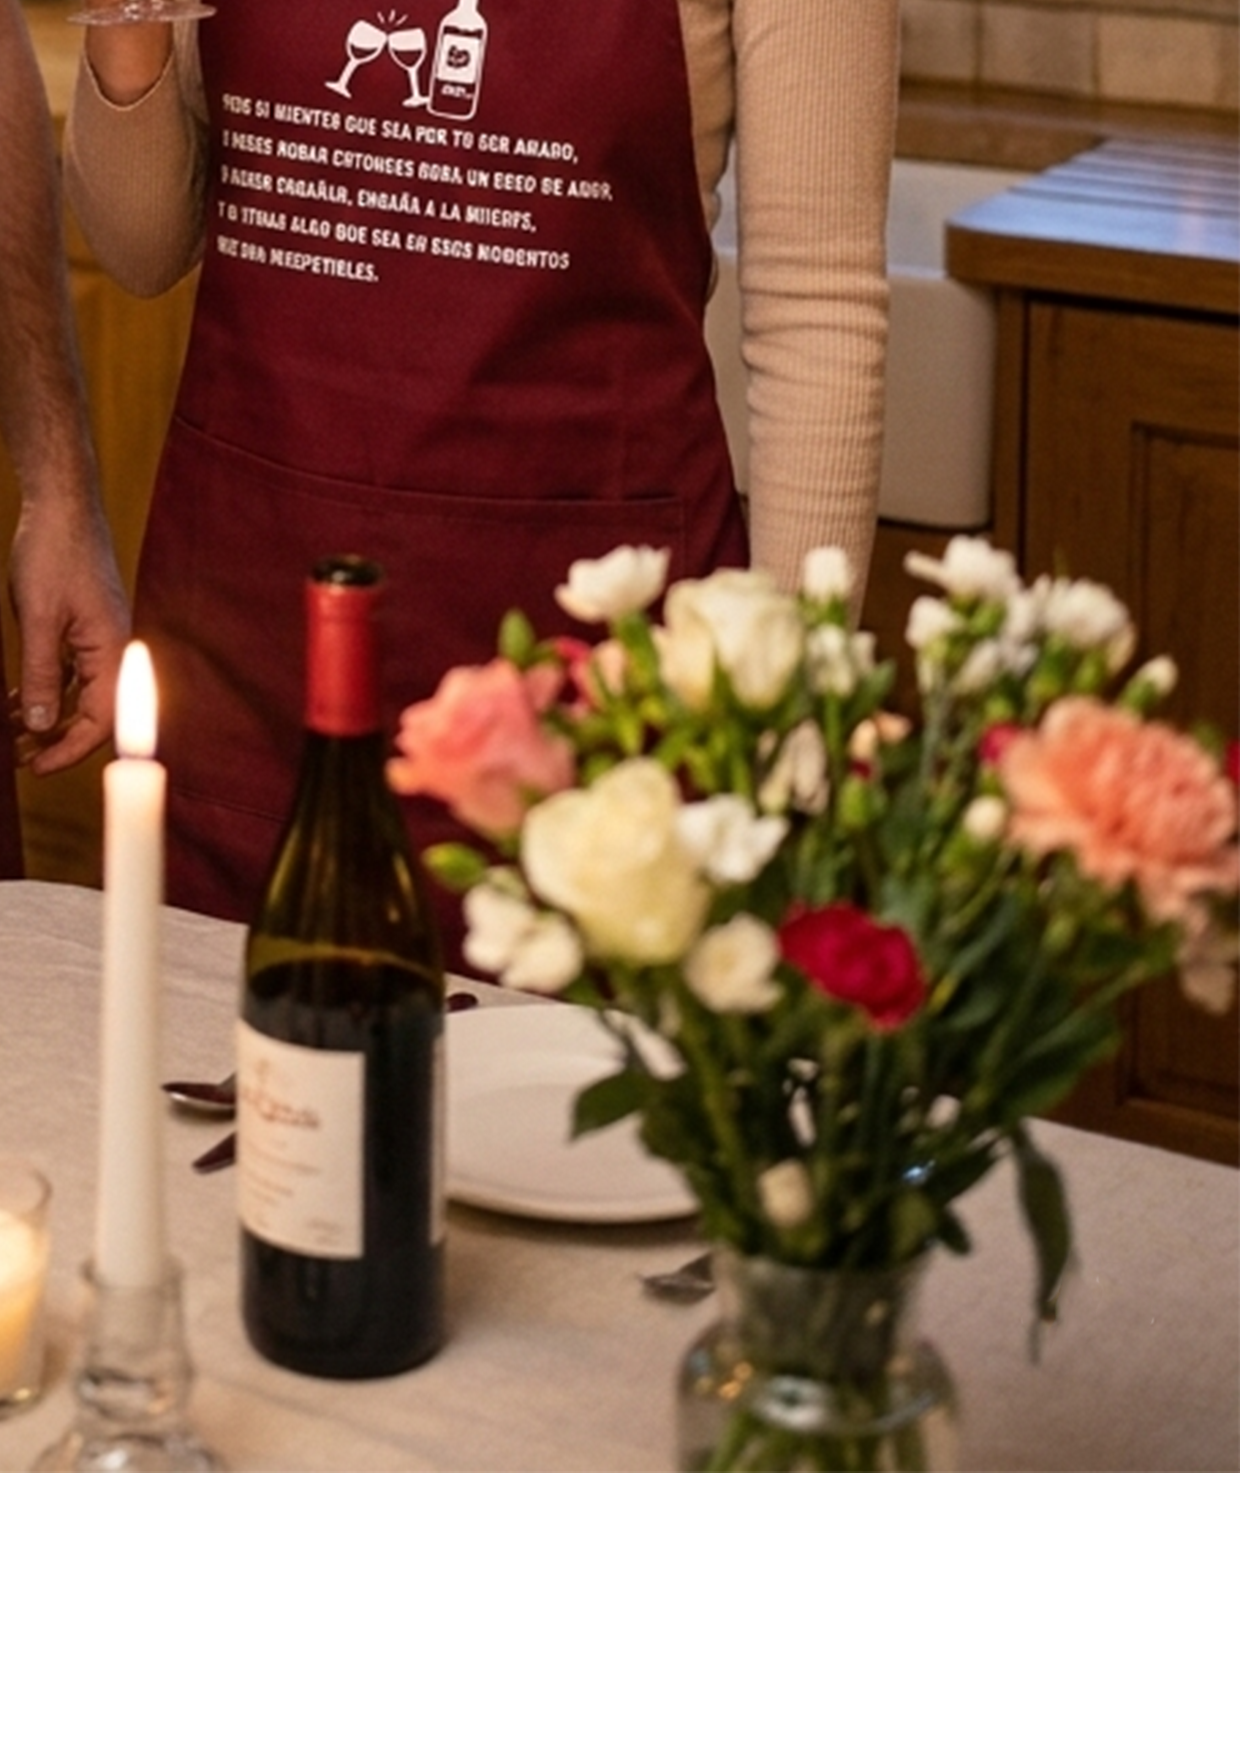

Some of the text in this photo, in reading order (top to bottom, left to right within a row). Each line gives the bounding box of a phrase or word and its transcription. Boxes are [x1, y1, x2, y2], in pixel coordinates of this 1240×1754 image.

[424, 199, 436, 217] A
[439, 202, 462, 221] LA
[371, 228, 402, 249] SEA
